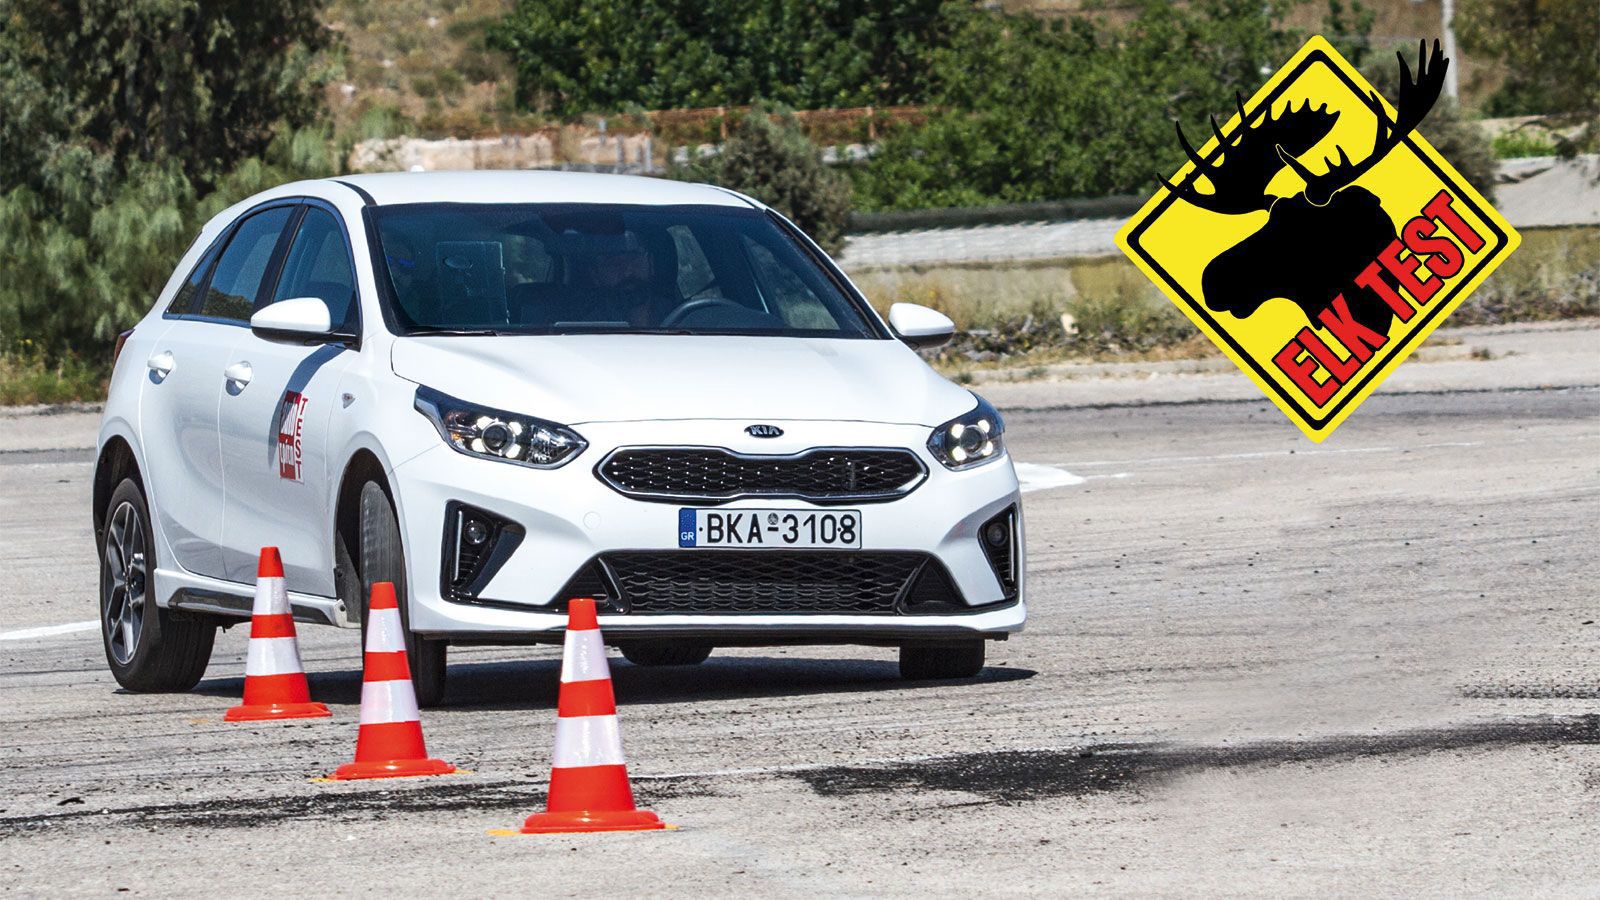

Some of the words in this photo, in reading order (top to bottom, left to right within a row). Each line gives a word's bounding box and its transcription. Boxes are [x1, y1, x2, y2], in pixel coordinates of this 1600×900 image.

[295, 397, 309, 480] TEST
[750, 425, 781, 435] KIA
[681, 531, 695, 541] GR
[706, 512, 856, 545] BKA-3108
